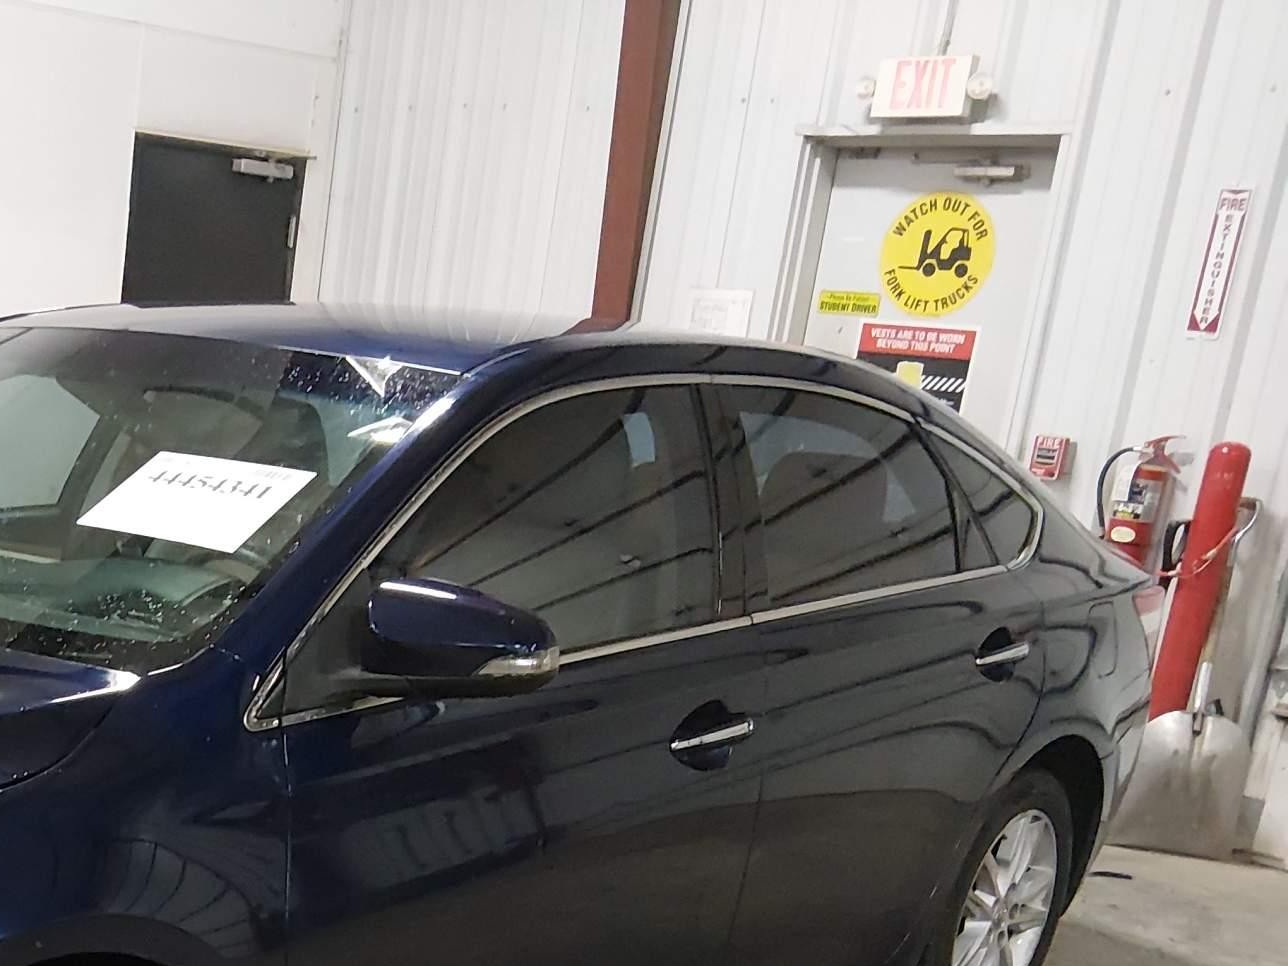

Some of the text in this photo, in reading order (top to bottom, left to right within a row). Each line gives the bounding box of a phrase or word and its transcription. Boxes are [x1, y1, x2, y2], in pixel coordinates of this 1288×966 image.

[889, 58, 957, 110] EXIT
[1219, 197, 1248, 212] FIRE
[893, 197, 989, 241] WATCH OUT FOR
[1199, 214, 1234, 325] EXTINGUISHER
[884, 268, 979, 313] FORK LIFT TRUCKS
[819, 301, 877, 314] STUDENT DRIVER
[871, 327, 966, 345] VESTS ARE TO BE WORN
[876, 338, 956, 354] BEYOND THIS POINT
[1037, 436, 1061, 449] FIRE
[148, 470, 273, 500] 44454341
